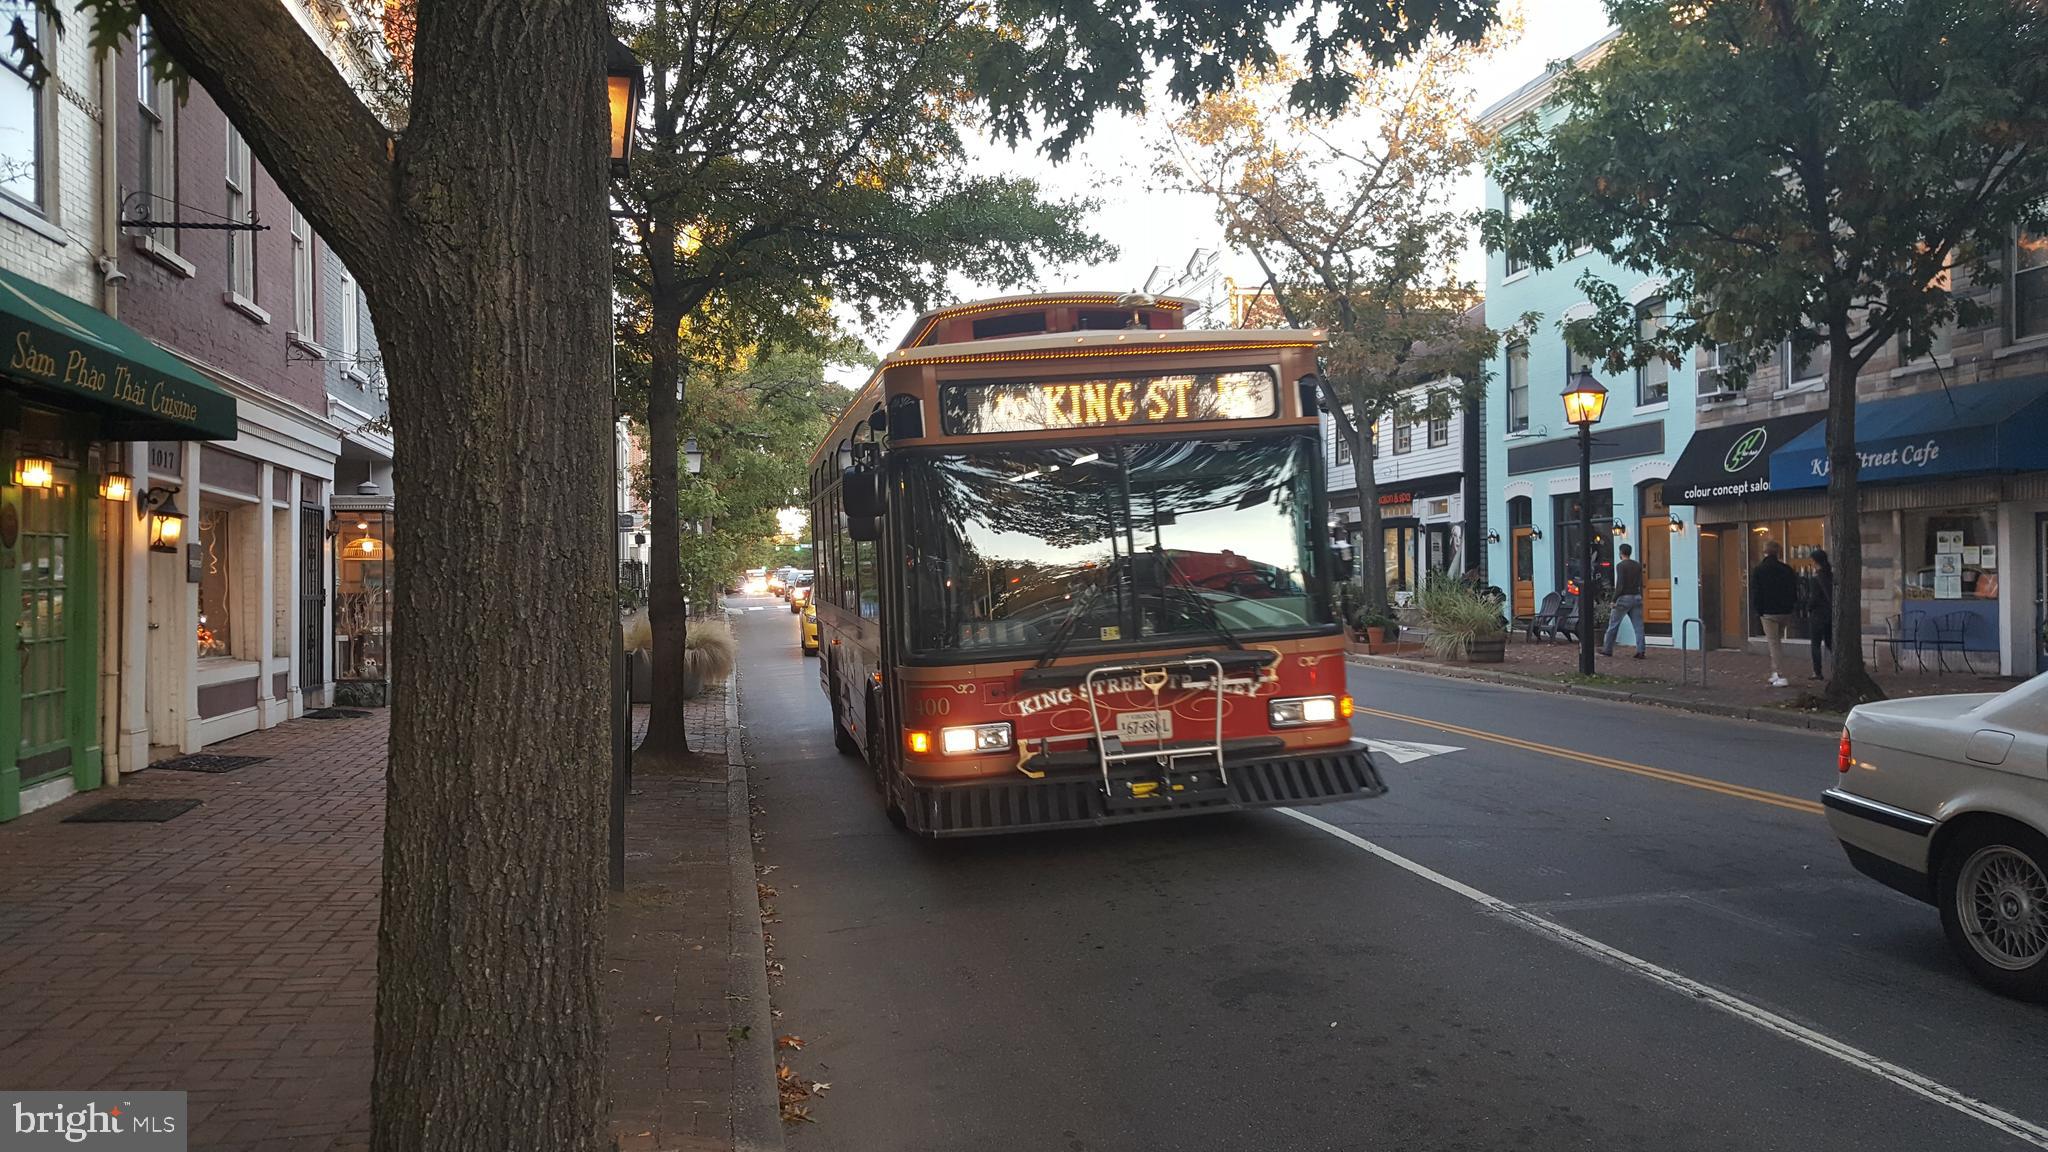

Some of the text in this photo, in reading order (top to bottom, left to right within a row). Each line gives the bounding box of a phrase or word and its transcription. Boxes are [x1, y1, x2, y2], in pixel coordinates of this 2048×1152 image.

[10, 331, 198, 423] Sam Phao Thai Cuisine
[1043, 382, 1134, 423] KING
[1149, 379, 1192, 419] ST
[151, 449, 175, 469] 1017
[1810, 440, 1940, 476] Ki treet Cafe
[1684, 485, 1711, 499] colour
[1712, 481, 1748, 496] concept
[1017, 688, 1073, 717] KING
